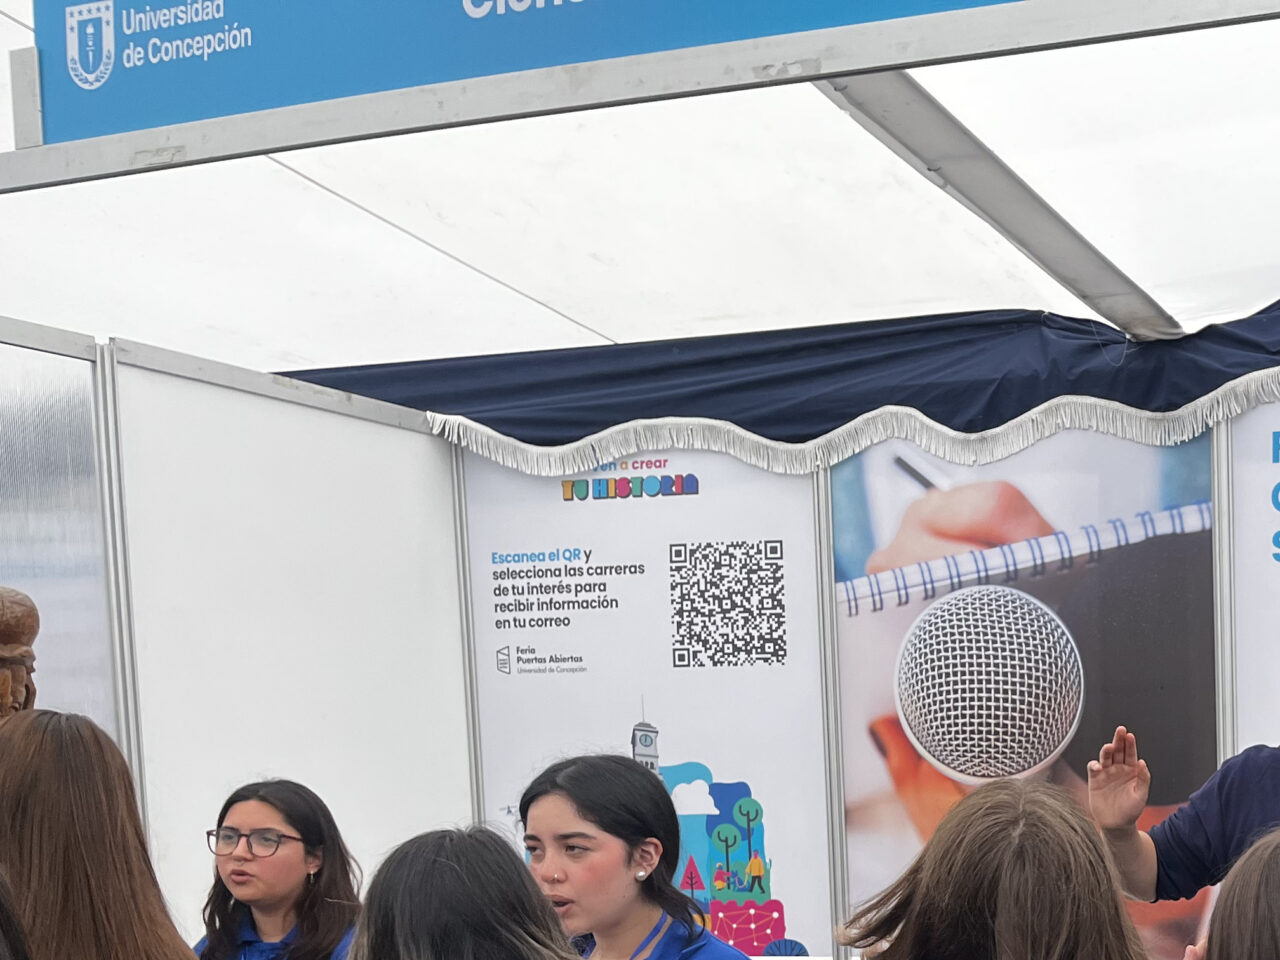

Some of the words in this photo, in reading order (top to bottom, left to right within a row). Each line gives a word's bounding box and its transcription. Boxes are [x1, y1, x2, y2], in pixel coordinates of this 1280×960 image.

[122, 0, 224, 35] Universidad
[122, 42, 145, 68] de
[148, 22, 252, 64] Concepción
[620, 461, 629, 470] a
[631, 458, 669, 470] crear
[561, 479, 589, 501] TU
[592, 473, 699, 500] HISTORIA
[491, 550, 547, 565] Escanea
[548, 549, 560, 562] el
[562, 548, 582, 563] QR
[583, 549, 593, 564] y
[492, 565, 562, 580] selecciona
[564, 564, 584, 578] las
[587, 563, 646, 577] carreras
[493, 582, 509, 597] de
[511, 583, 525, 596] tu
[526, 580, 572, 596] interés
[574, 582, 607, 598] para
[494, 598, 535, 613] recibir
[536, 596, 619, 611] información
[495, 618, 511, 630] en
[513, 617, 526, 629] tu
[528, 616, 571, 628] correo
[516, 646, 536, 655] Feria
[516, 655, 546, 665] Puertas
[548, 653, 583, 664] Abiertas
